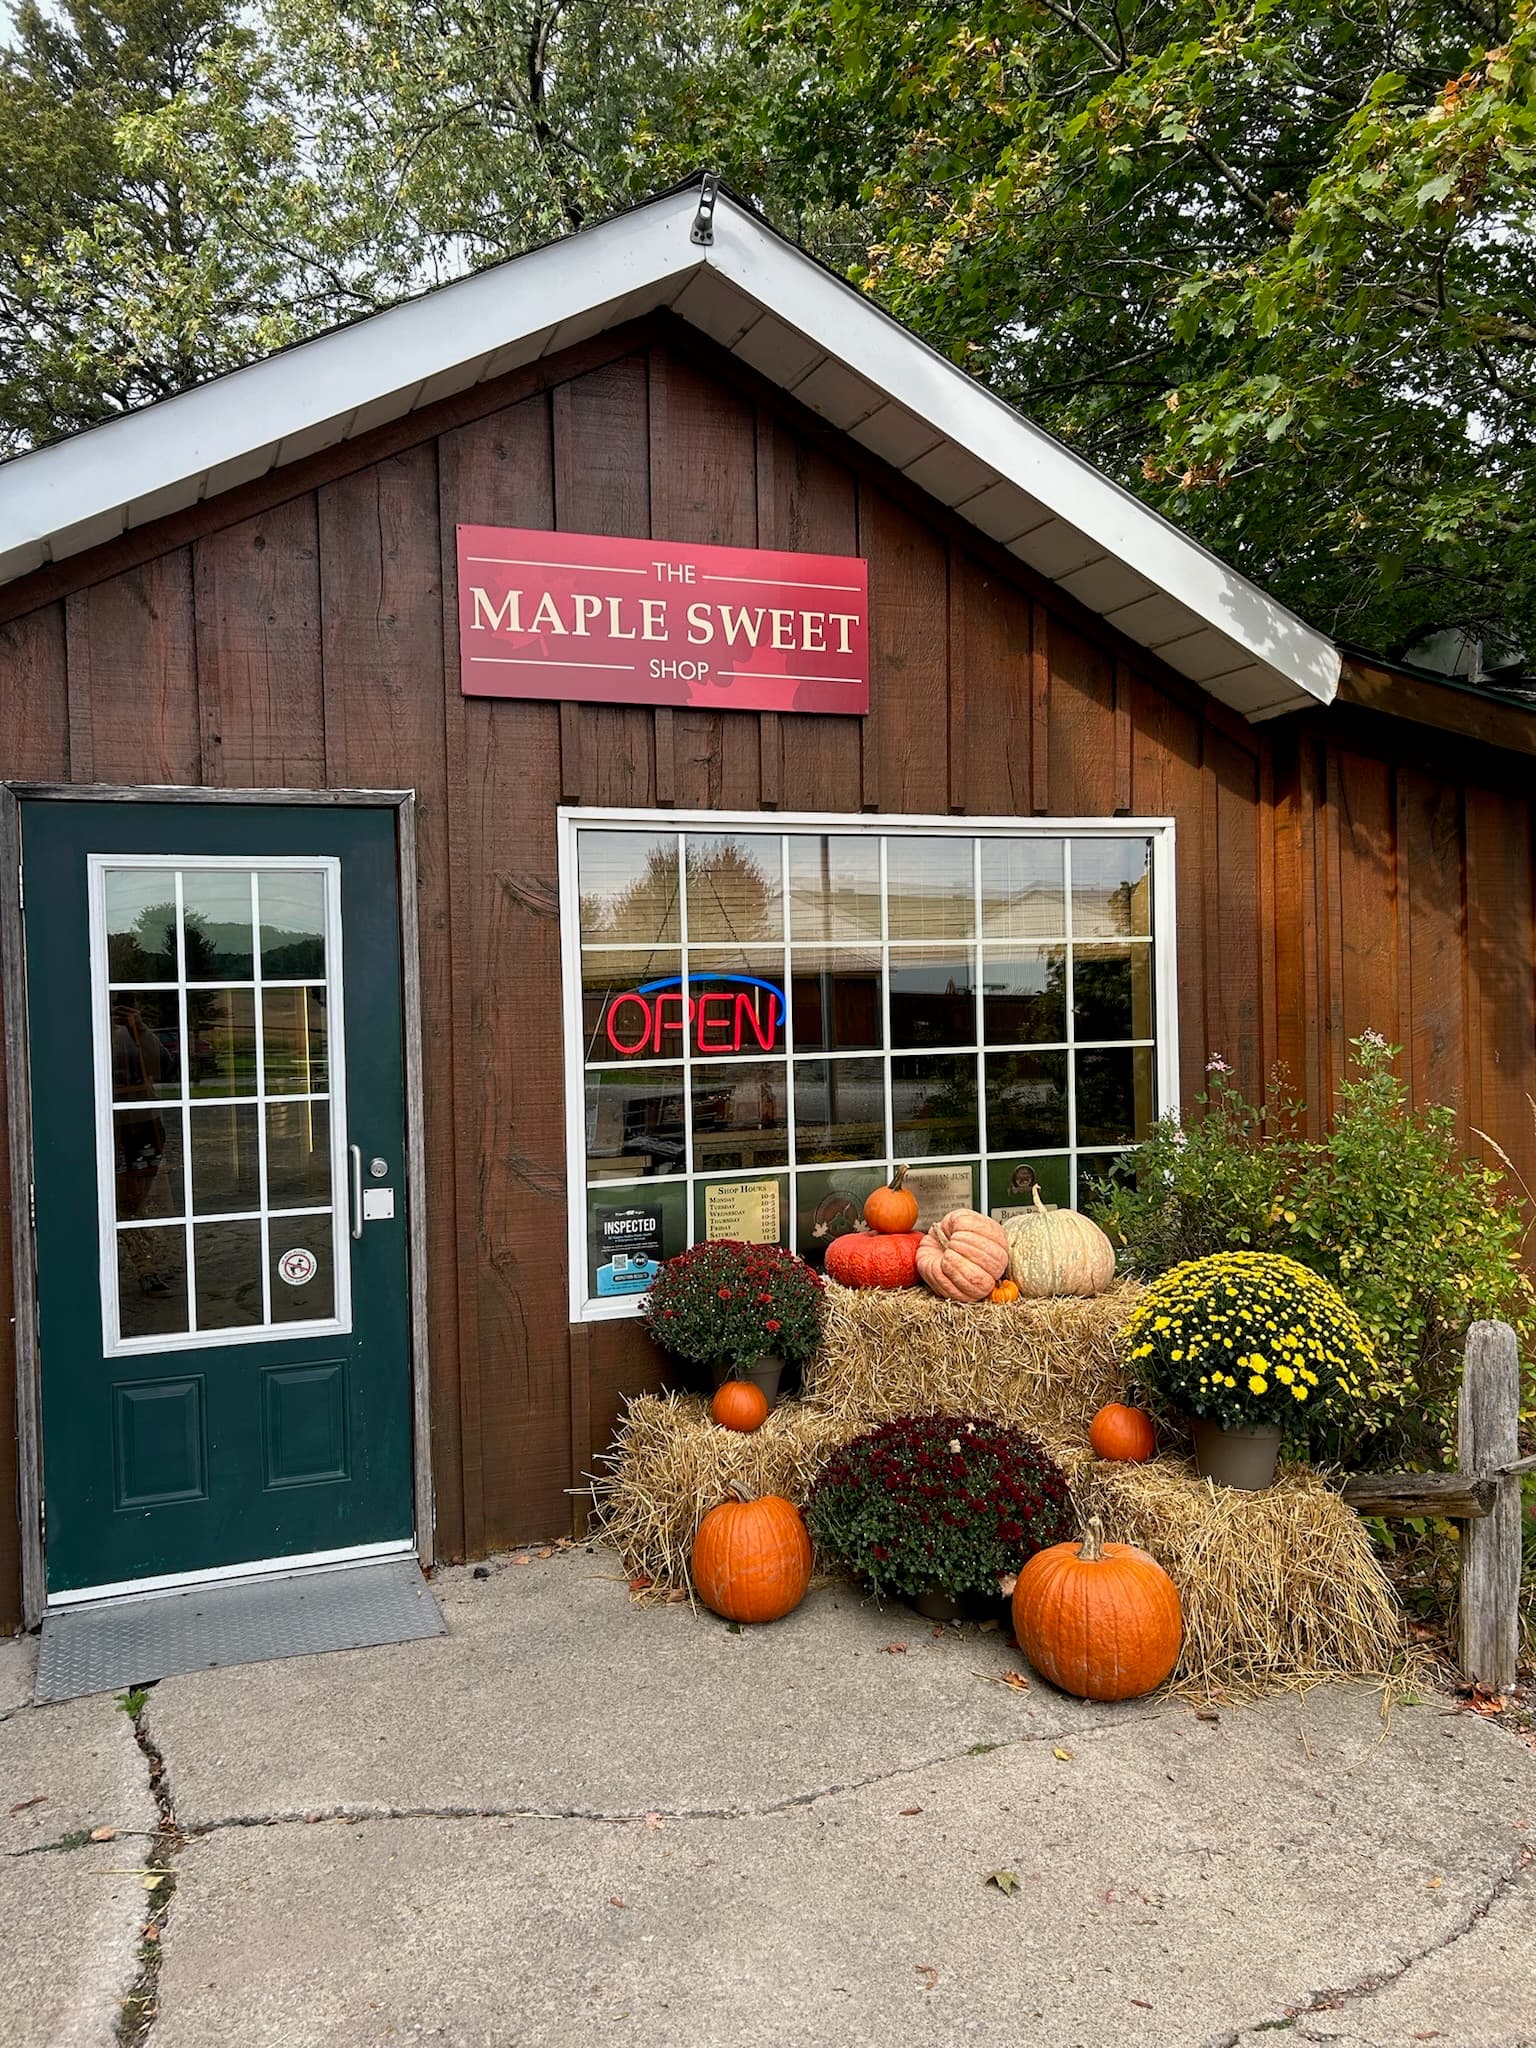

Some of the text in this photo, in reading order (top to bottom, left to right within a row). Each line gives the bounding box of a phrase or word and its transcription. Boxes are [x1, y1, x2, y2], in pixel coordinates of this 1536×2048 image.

[651, 561, 697, 585] THE
[468, 586, 860, 654] MAPLE SWEET
[649, 658, 709, 681] SHOP
[606, 993, 776, 1054] OPEN
[951, 1172, 969, 1180] JUST
[717, 1185, 767, 1195] SHOP HOURS
[603, 1217, 656, 1235] INSPECTED
